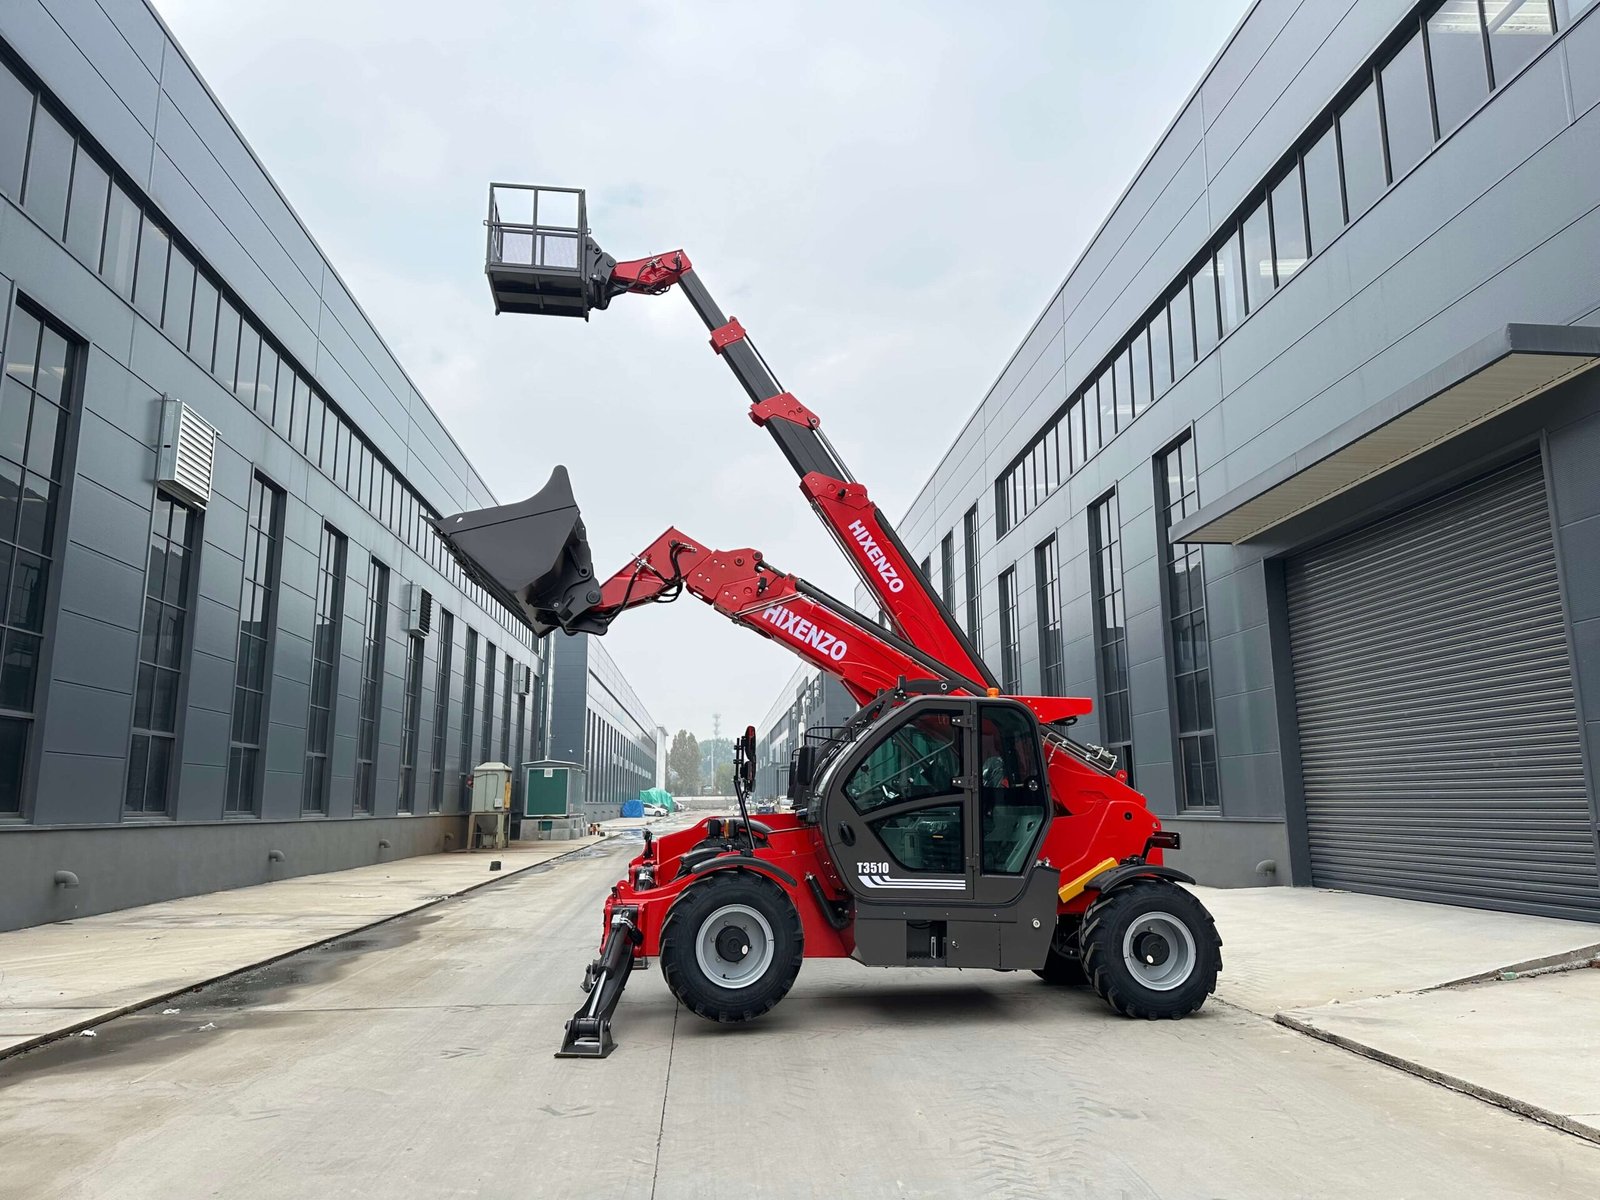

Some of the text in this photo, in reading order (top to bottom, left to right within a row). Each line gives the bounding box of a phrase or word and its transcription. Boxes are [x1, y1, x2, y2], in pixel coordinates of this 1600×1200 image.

[848, 519, 904, 593] HIXENZO
[762, 604, 848, 661] HIXENZO
[857, 862, 889, 874] T3510
